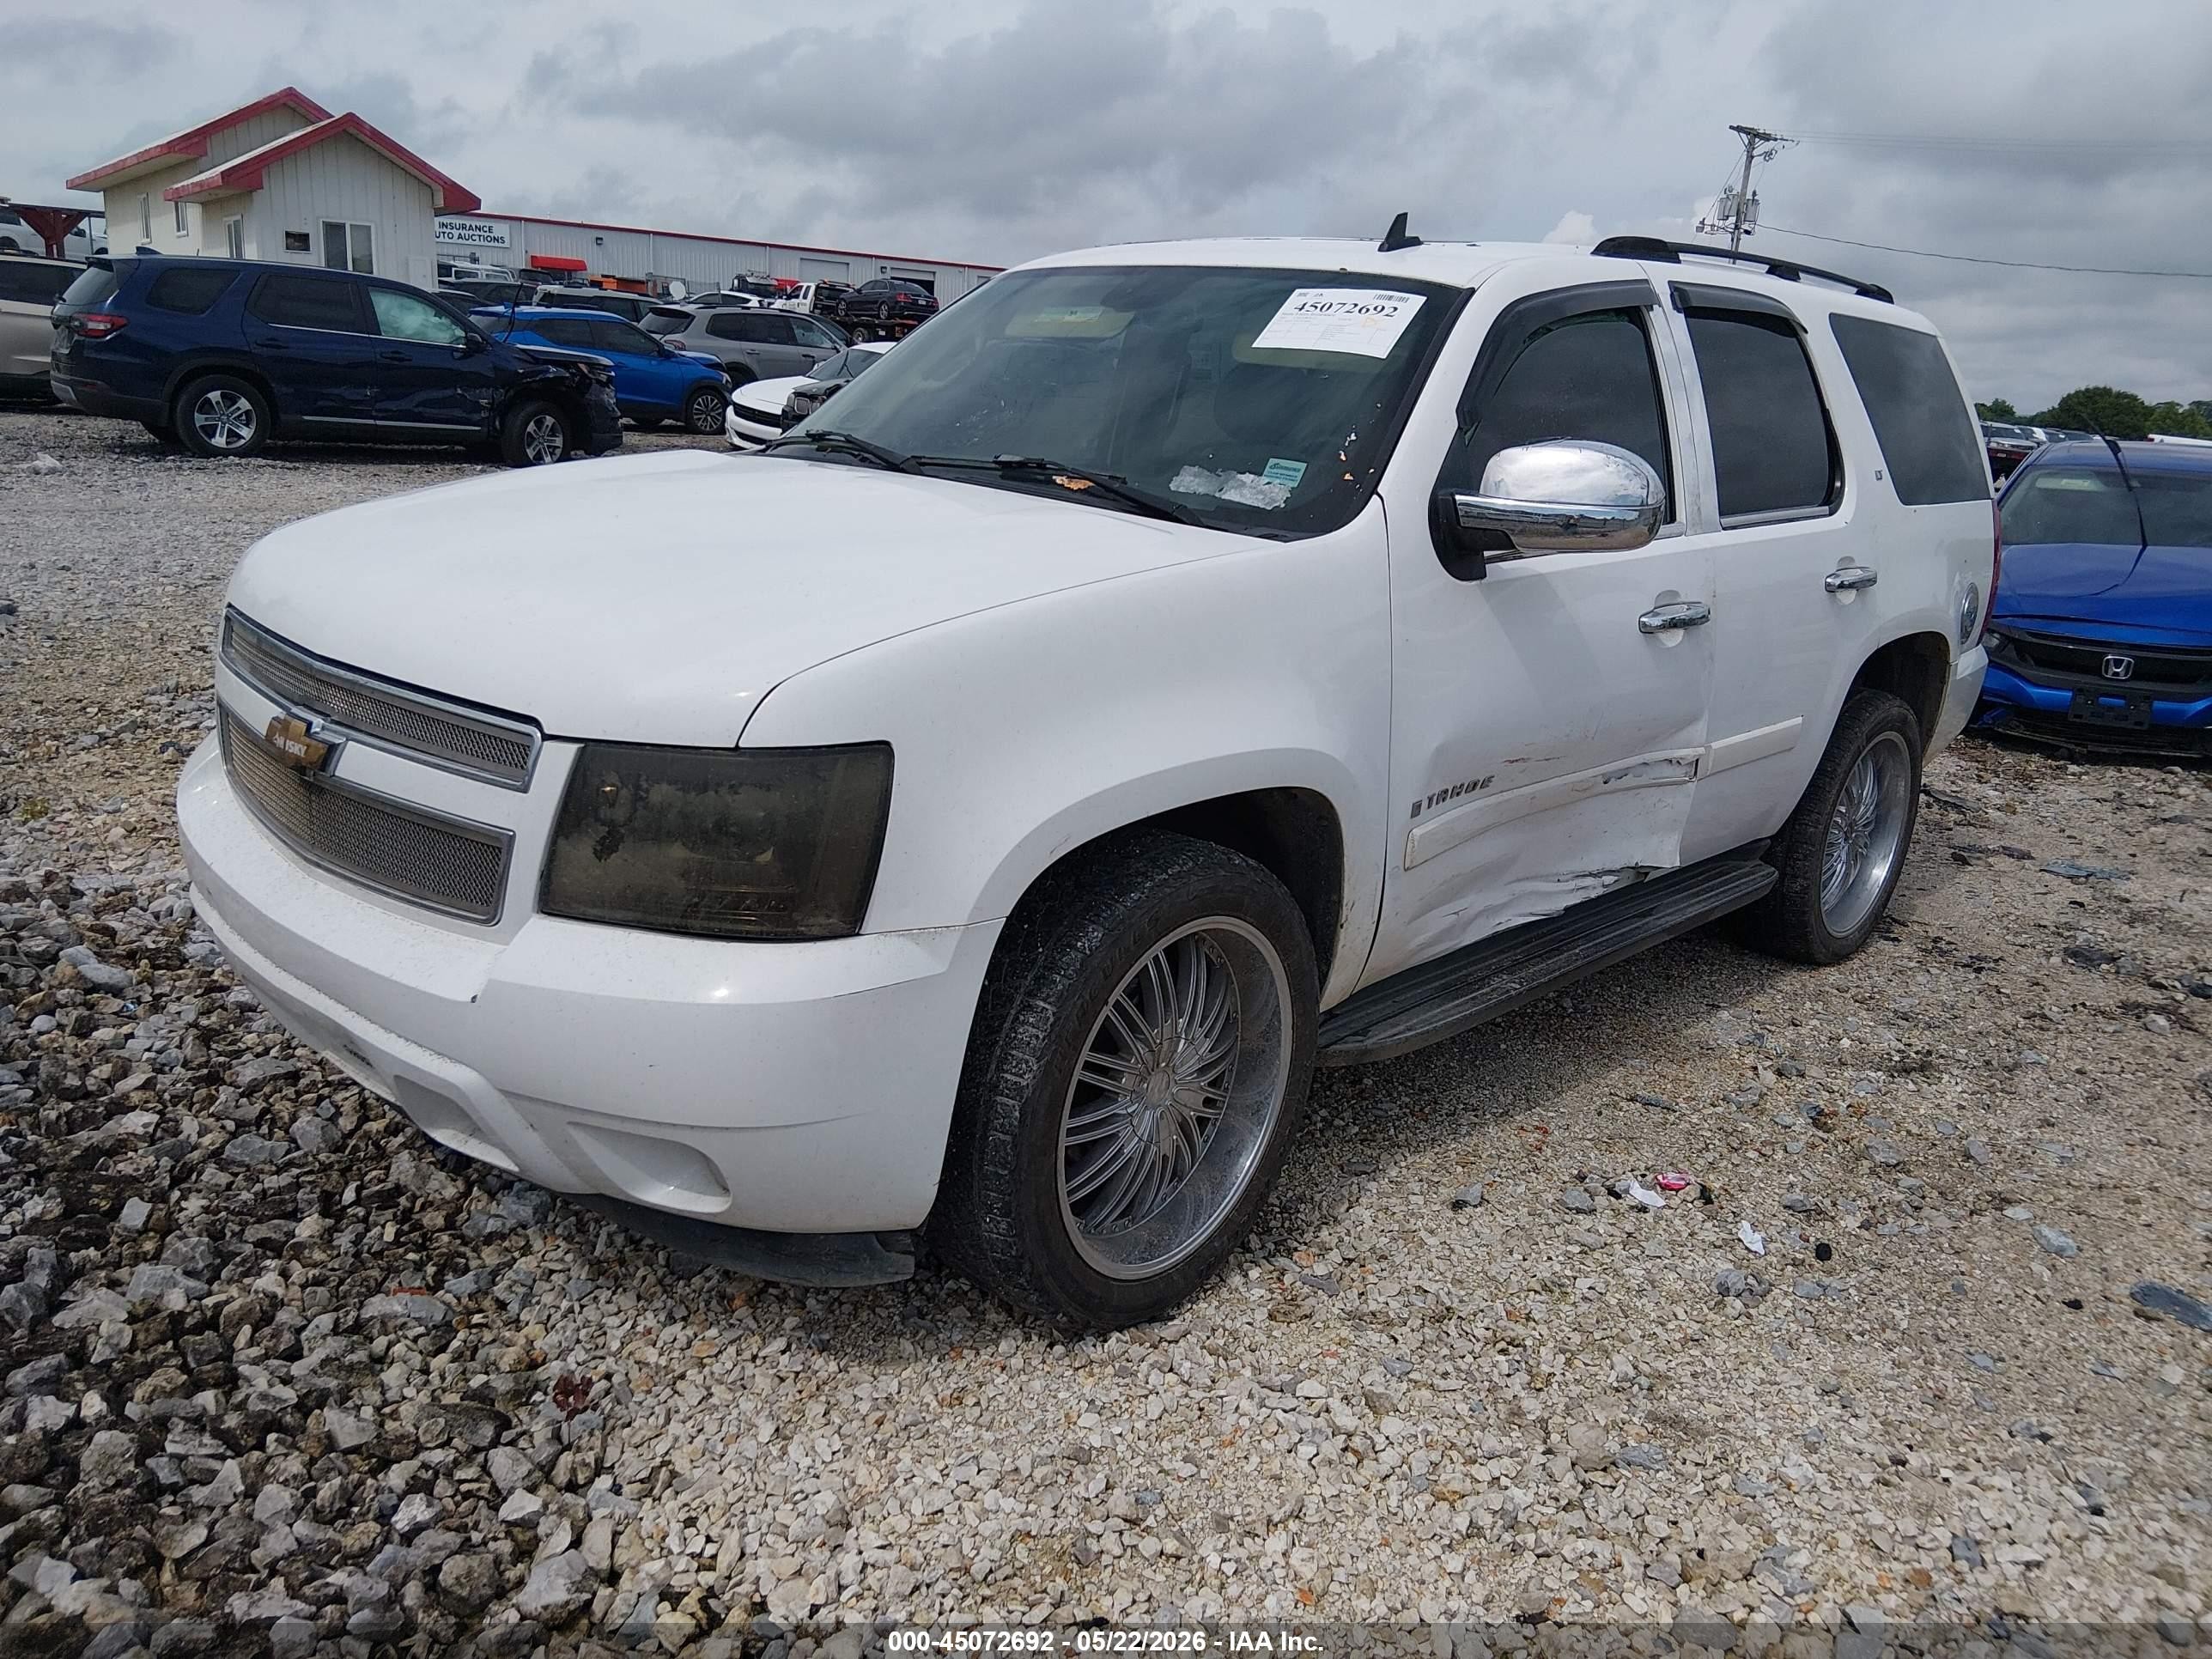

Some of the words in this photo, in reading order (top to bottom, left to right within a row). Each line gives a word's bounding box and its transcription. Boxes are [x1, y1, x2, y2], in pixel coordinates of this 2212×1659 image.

[438, 221, 494, 234] INSURANCE
[434, 231, 454, 240] UTO
[457, 233, 506, 245] AUCTIONS
[1293, 301, 1399, 318] 45072692
[1426, 775, 1495, 810] TAHOE
